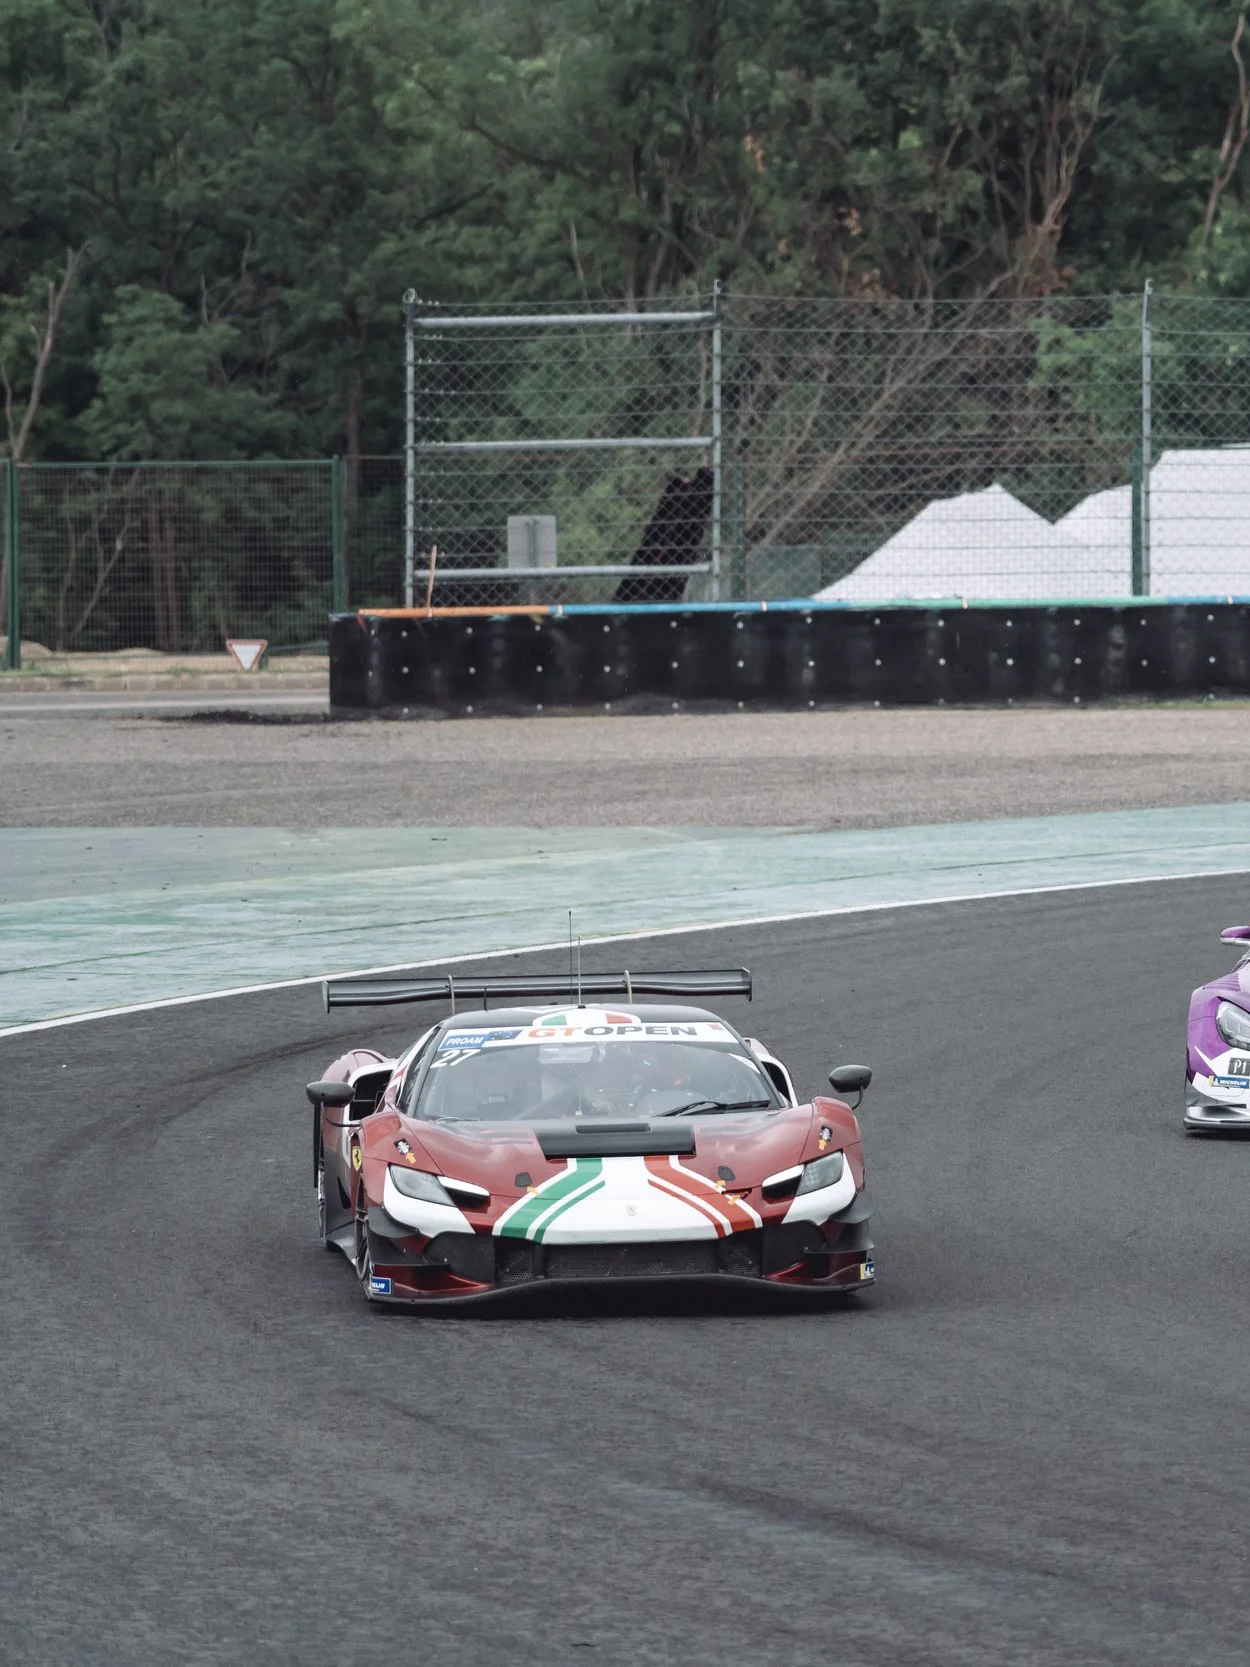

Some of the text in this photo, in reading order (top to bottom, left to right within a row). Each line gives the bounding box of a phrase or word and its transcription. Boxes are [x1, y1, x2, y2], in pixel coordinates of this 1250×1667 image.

[445, 1036, 484, 1046] PROAM
[430, 1049, 482, 1069] 27
[1219, 1079, 1247, 1087] MICHELIN
